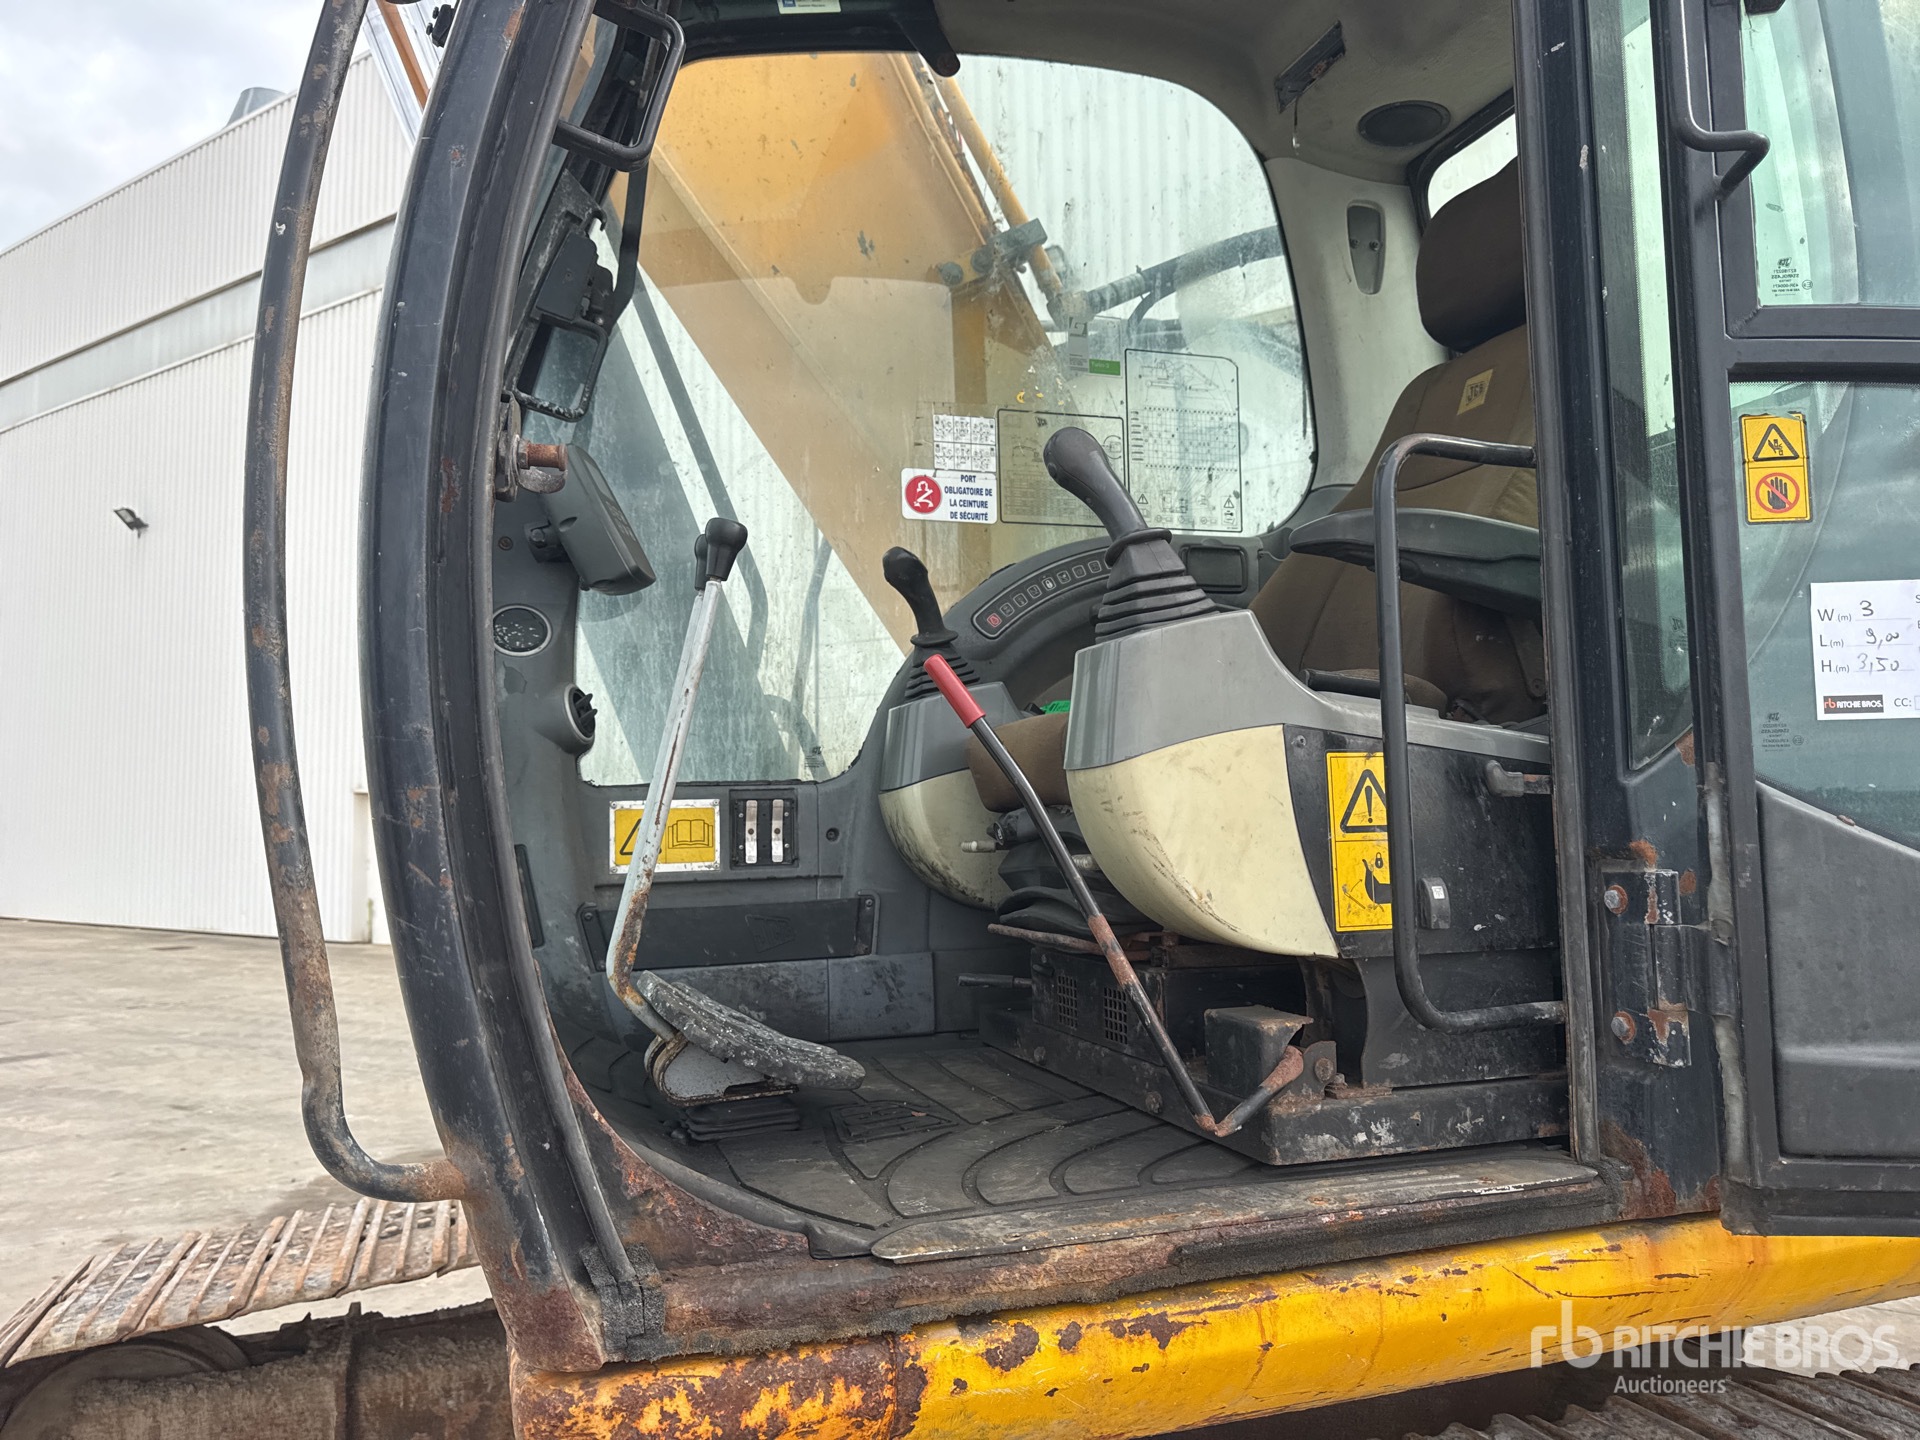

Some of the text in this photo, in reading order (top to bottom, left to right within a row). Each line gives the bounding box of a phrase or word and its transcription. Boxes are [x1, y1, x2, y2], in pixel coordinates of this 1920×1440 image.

[1466, 381, 1486, 405] JCB
[960, 474, 977, 483] PORT
[944, 486, 993, 497] OBLIGATOIRE DE
[949, 499, 989, 509] LA CEINTURE
[950, 511, 989, 521] DE SÉCURITÉ
[1860, 600, 1874, 617] 3
[1857, 652, 1900, 676] 3,50
[1861, 700, 1884, 708] BROS.
[1893, 697, 1912, 707] CC:
